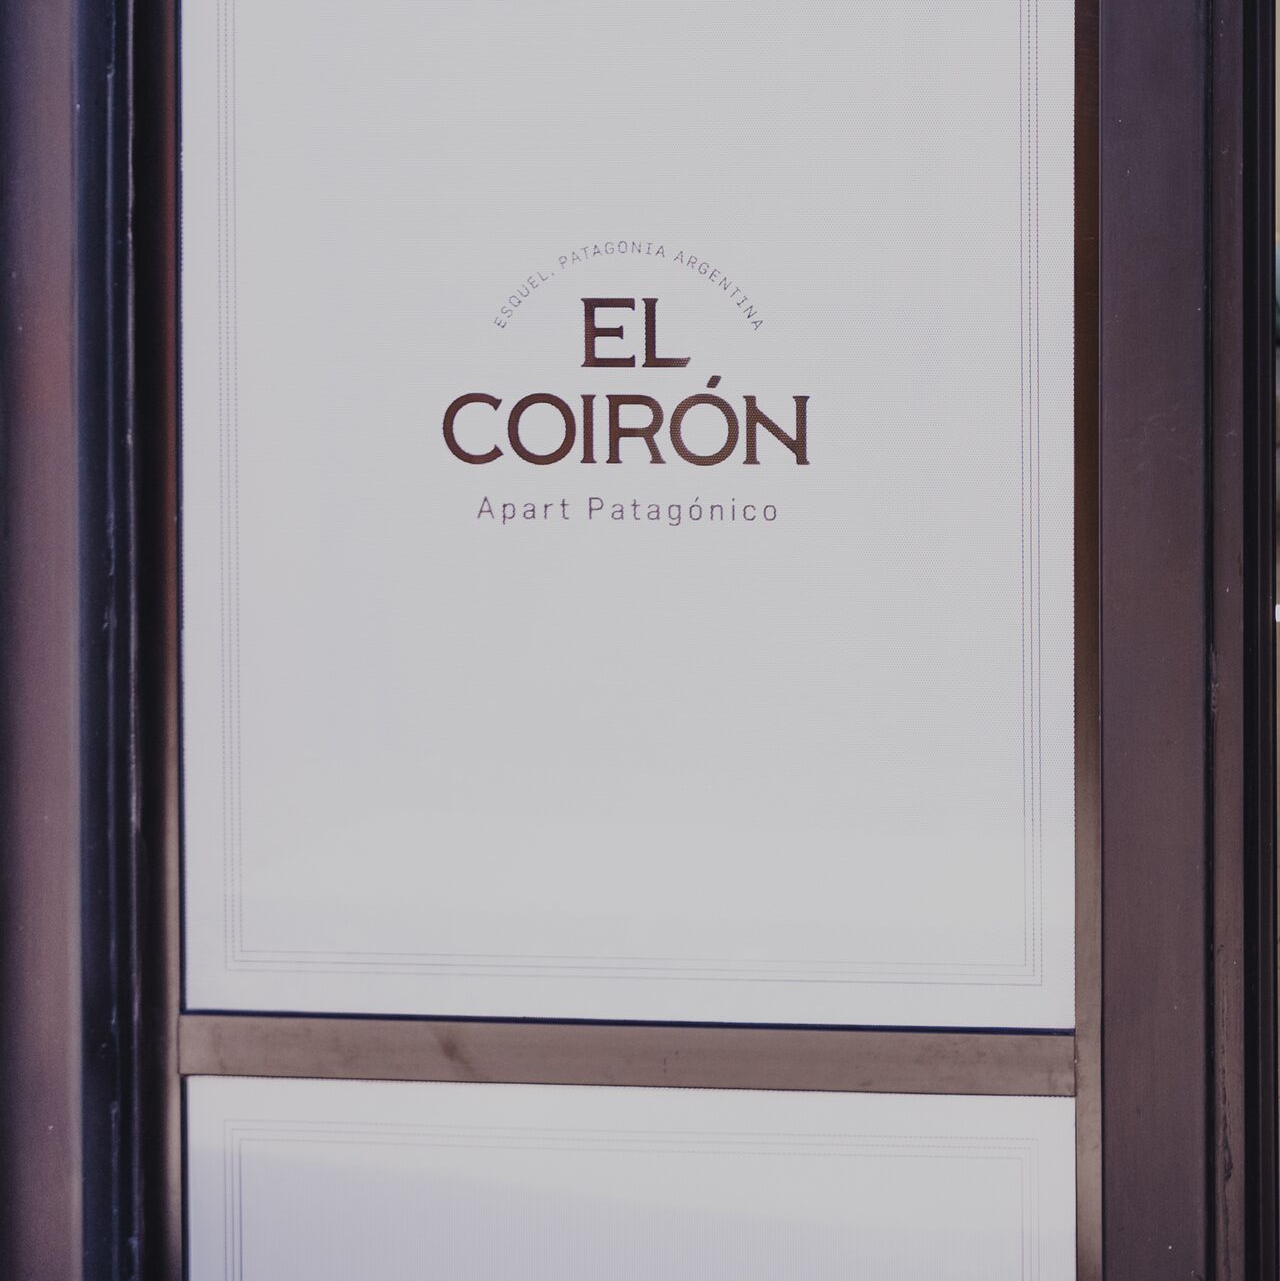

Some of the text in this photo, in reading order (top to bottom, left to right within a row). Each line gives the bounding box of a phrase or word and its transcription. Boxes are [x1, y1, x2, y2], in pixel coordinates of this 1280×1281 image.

[558, 240, 665, 270] PATAGONIA
[673, 250, 764, 331] ARGENTINA
[580, 297, 691, 368] EL
[442, 374, 811, 466] COIRÓN
[477, 496, 778, 527] Apart Patagónico
